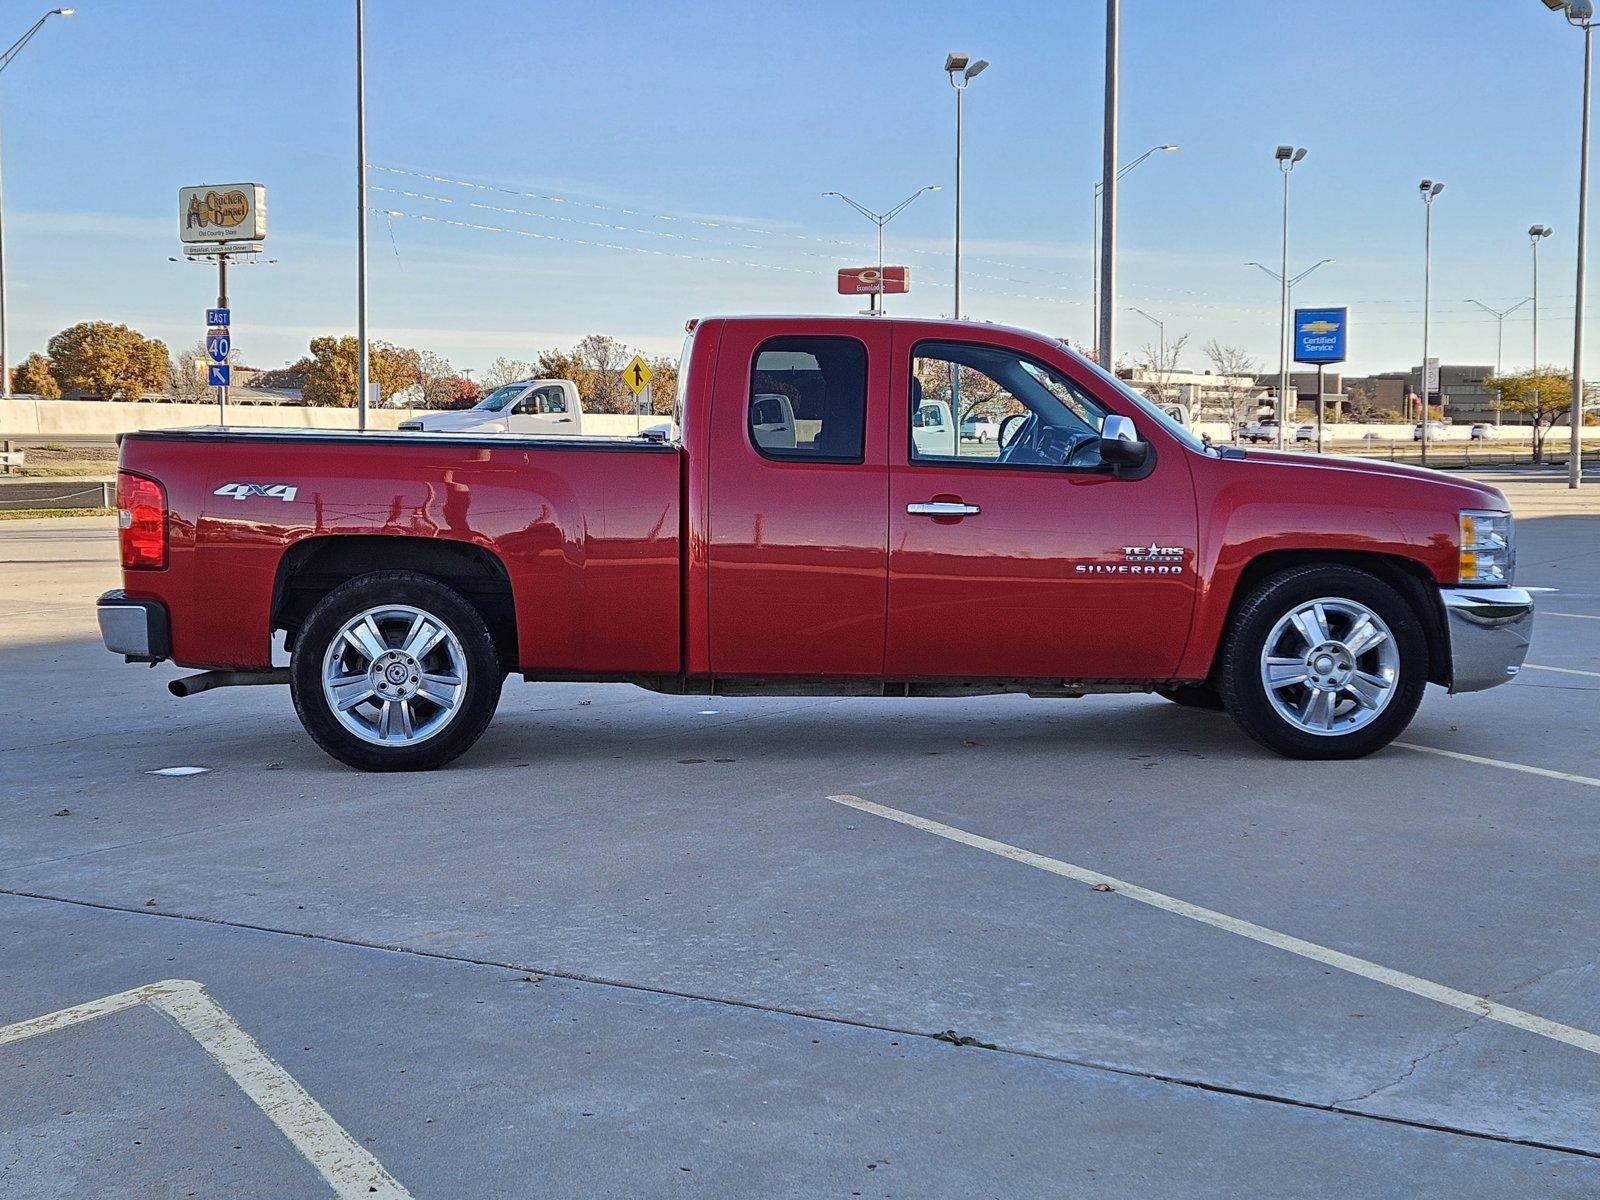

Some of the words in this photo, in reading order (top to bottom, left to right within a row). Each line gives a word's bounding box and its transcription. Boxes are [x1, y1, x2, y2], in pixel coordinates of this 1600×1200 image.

[207, 193, 243, 211] Cracker
[214, 205, 245, 225] Barrel
[209, 312, 228, 323] EAST
[1303, 336, 1337, 344] Certified
[209, 339, 228, 357] 40
[1075, 565, 1183, 574] SILVERADO
